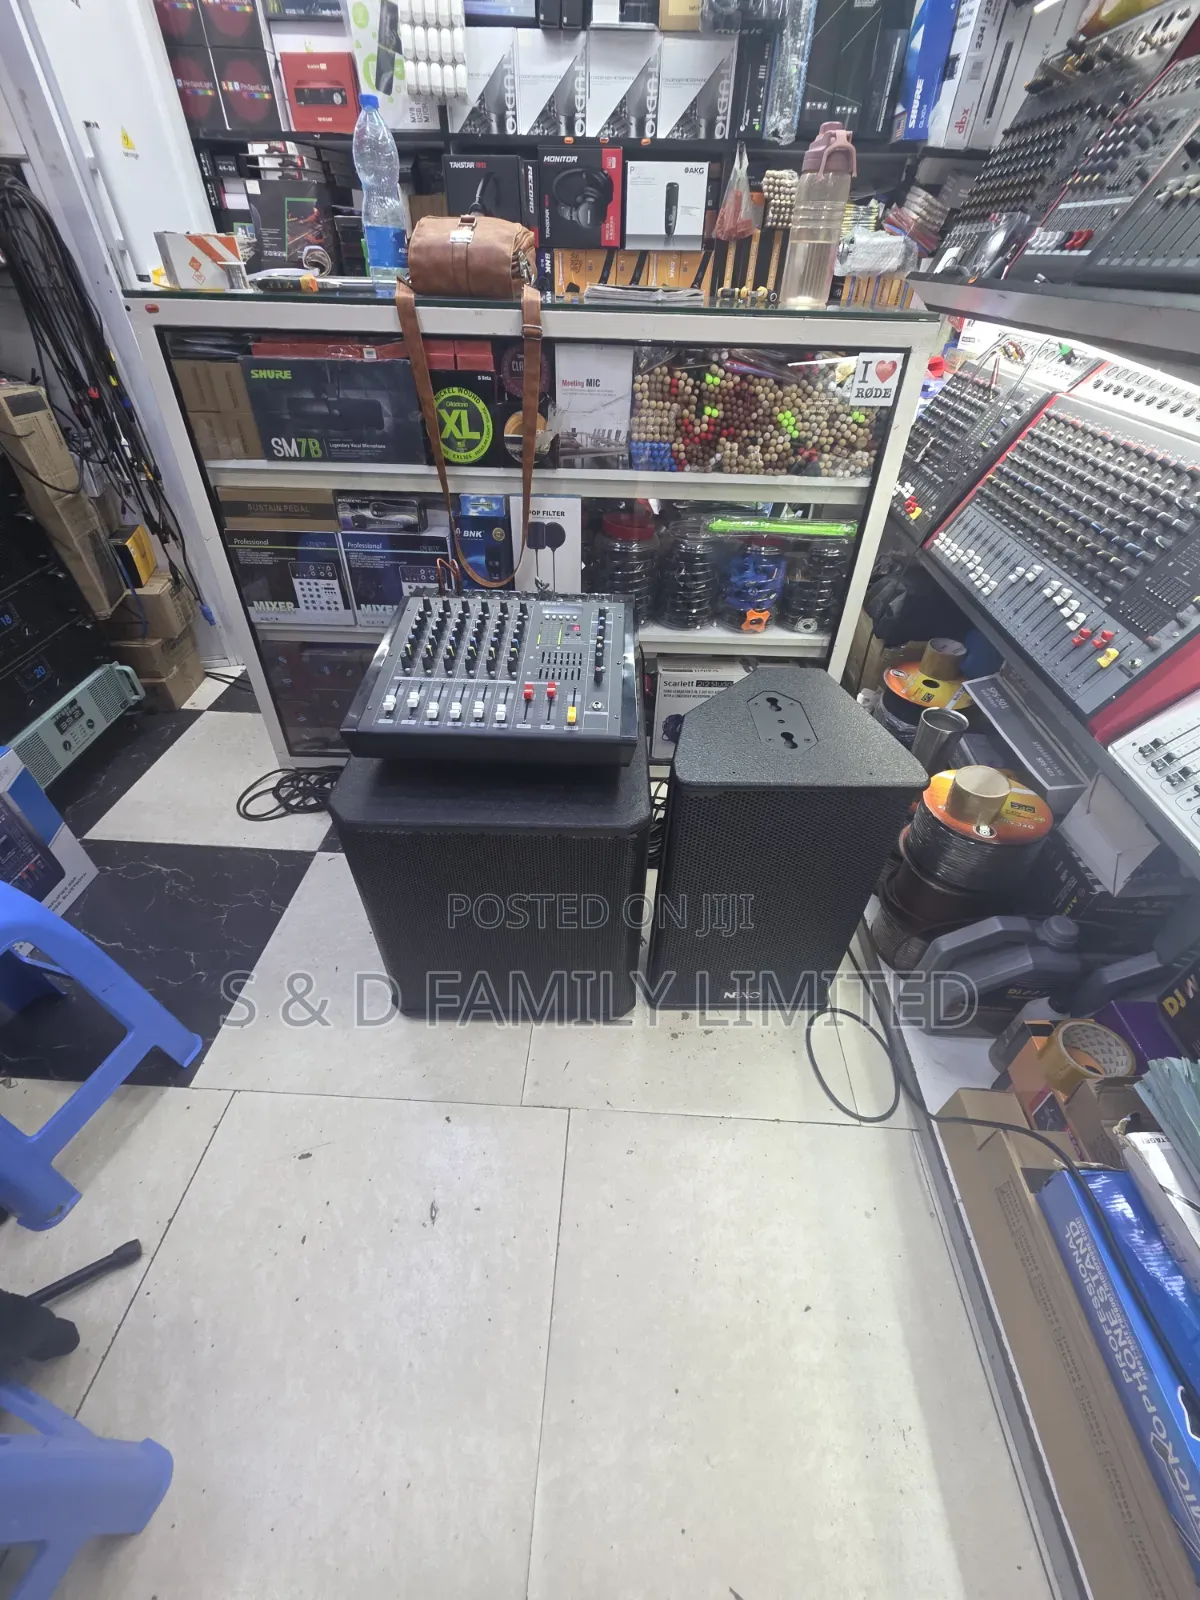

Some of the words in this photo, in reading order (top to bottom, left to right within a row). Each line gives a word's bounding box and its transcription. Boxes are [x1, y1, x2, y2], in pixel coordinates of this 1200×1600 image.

[908, 78, 924, 129] SHURE
[954, 108, 970, 134] dbx
[543, 155, 578, 163] MONITOR
[250, 369, 292, 380] SHURE
[858, 360, 873, 383] I
[562, 379, 585, 388] Meeting
[586, 379, 601, 388] MIC
[855, 387, 892, 398] RØDE
[438, 408, 480, 440] XL
[271, 437, 323, 458] SM7B
[247, 503, 282, 512] SUSTAIN
[284, 504, 310, 513] PEDAL
[463, 530, 482, 538] BNK
[253, 600, 296, 612] MIXER
[34, 665, 46, 679] 20
[1069, 1221, 1108, 1304] STAND
[1064, 1225, 1133, 1384] PROFESSIONAL
